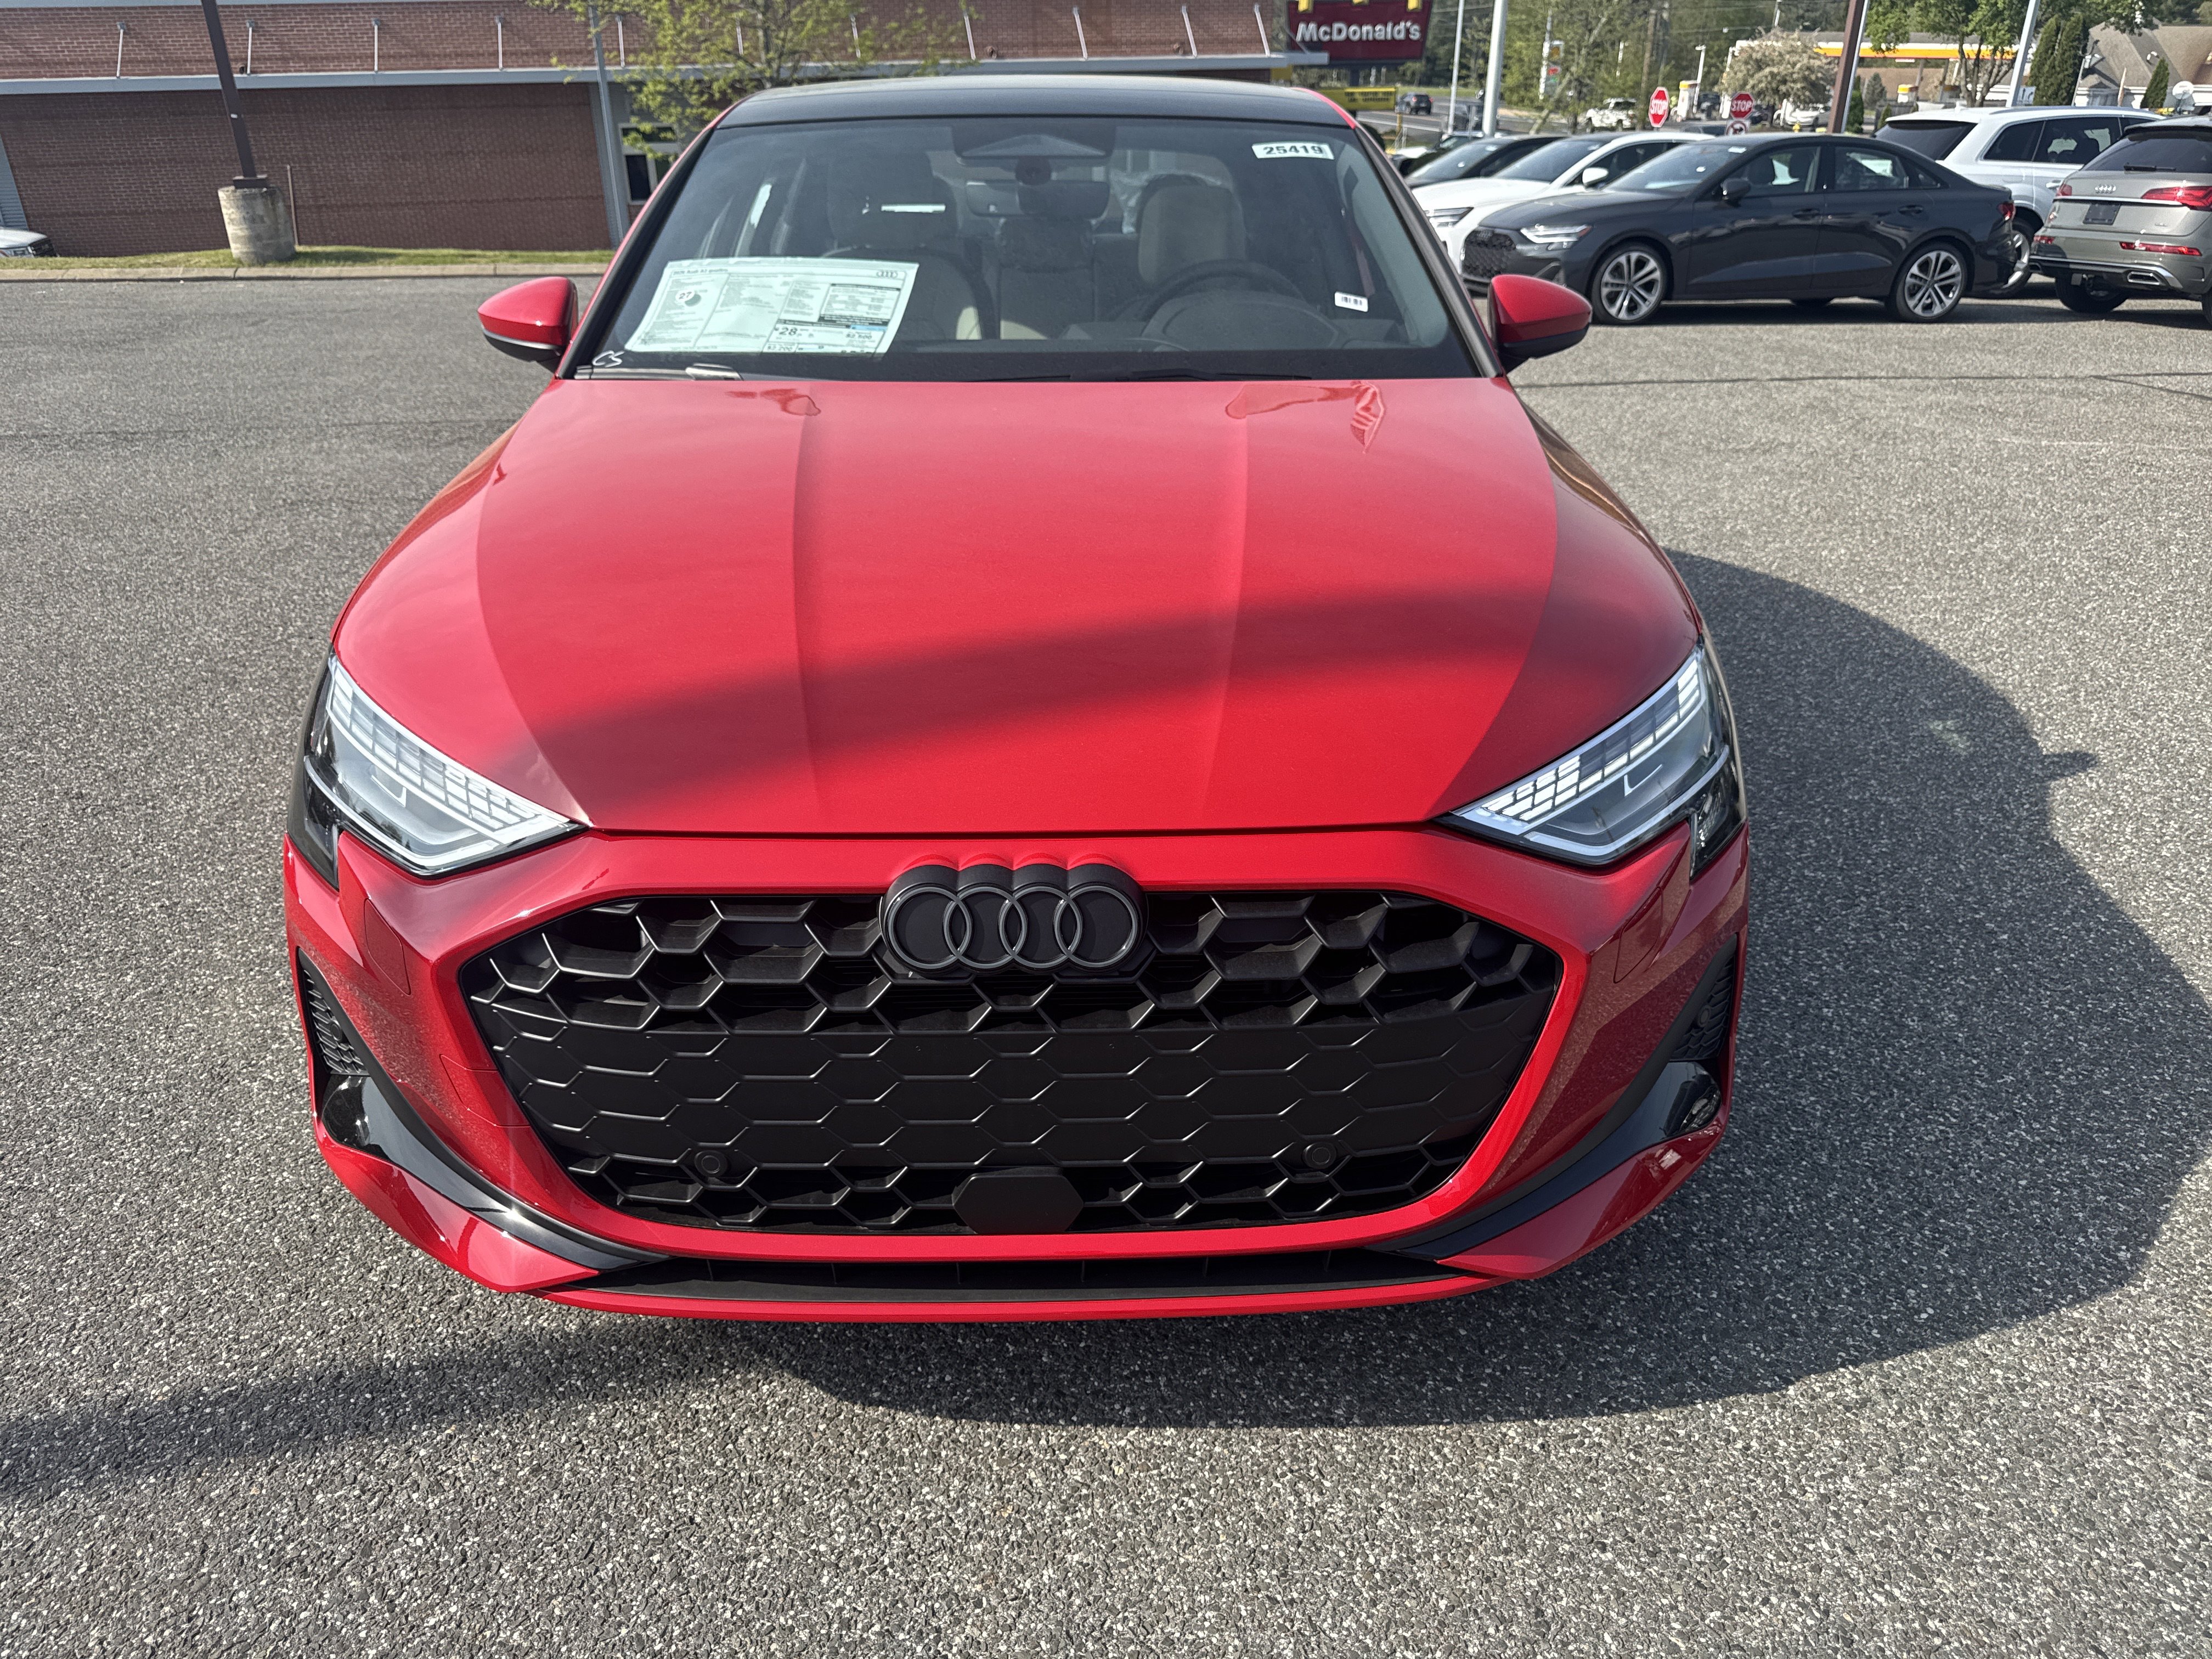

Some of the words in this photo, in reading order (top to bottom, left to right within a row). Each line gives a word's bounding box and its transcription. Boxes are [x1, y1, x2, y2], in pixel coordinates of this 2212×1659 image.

[1296, 21, 1421, 42] McDonald's
[1650, 100, 1668, 115] STOP
[1731, 100, 1752, 111] STOP
[1263, 145, 1323, 154] 25419
[678, 291, 692, 300] 27
[779, 326, 798, 335] 28
